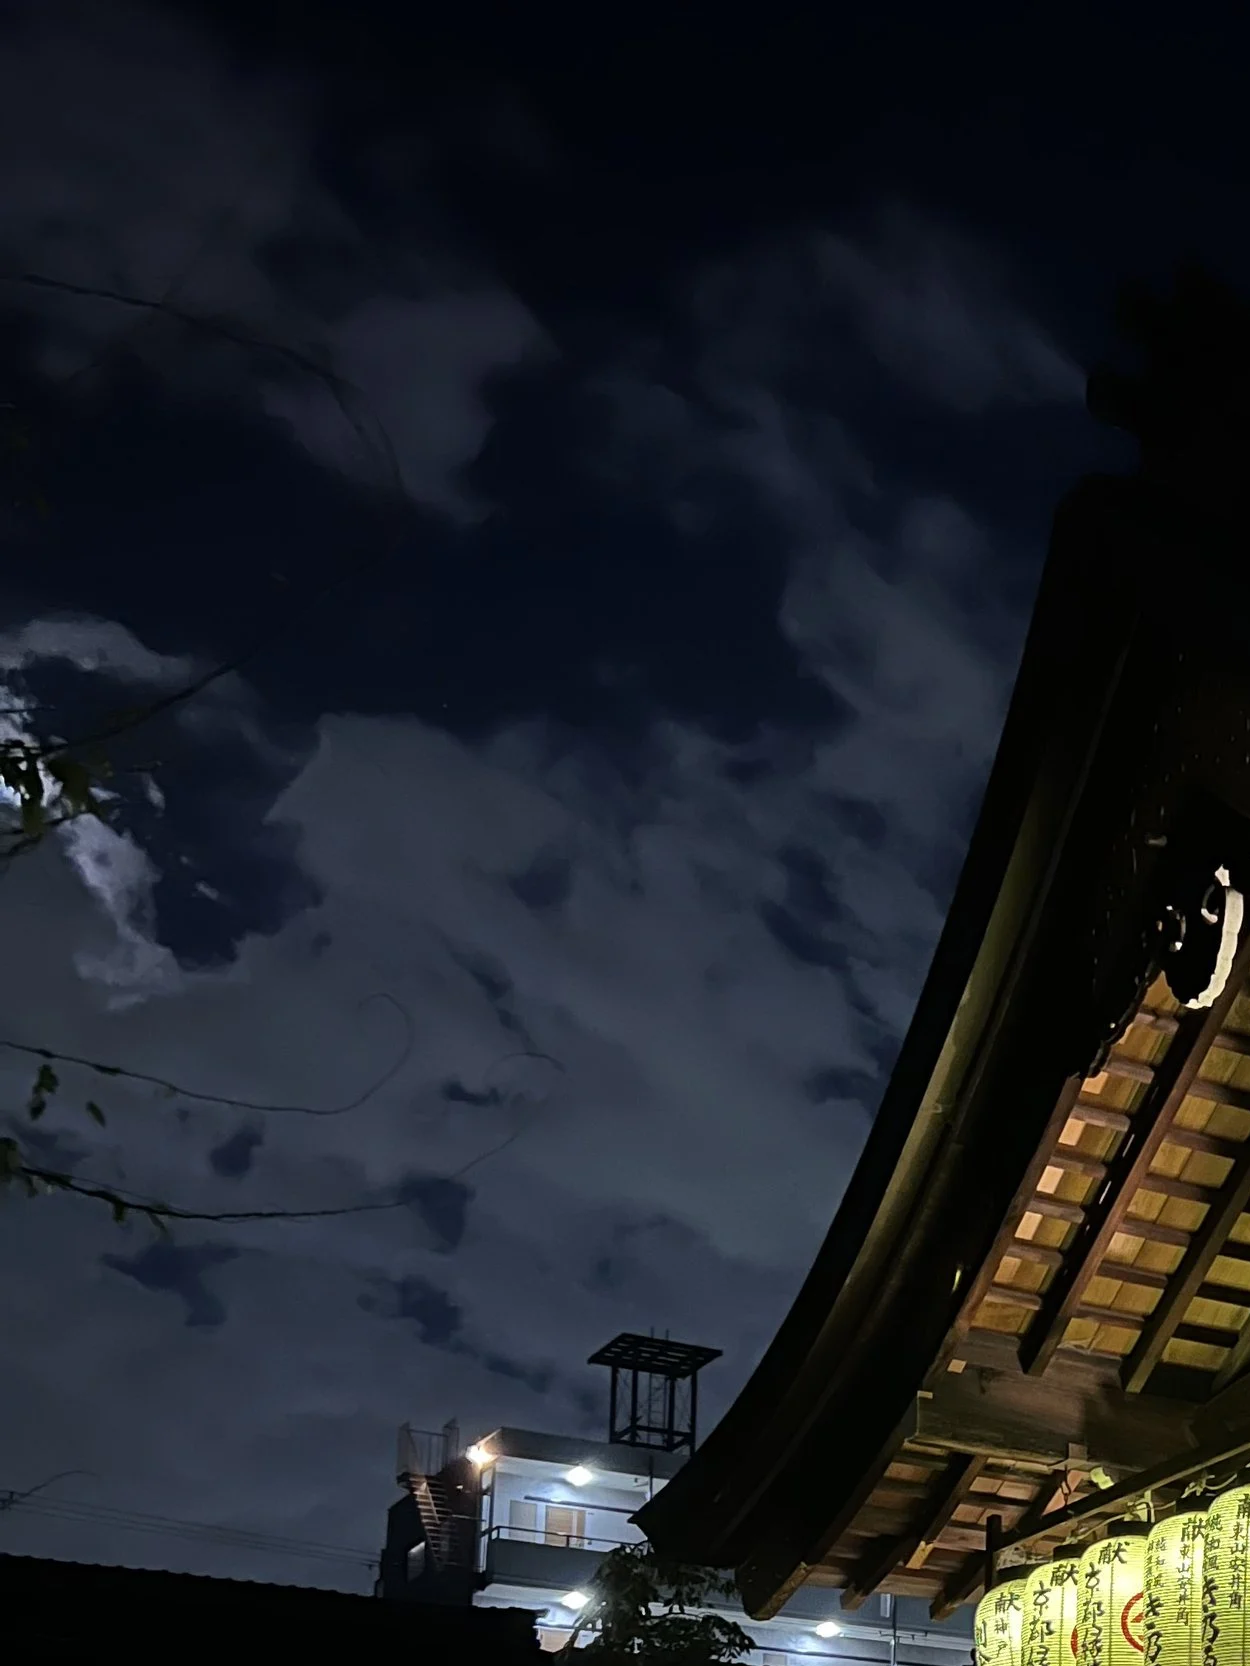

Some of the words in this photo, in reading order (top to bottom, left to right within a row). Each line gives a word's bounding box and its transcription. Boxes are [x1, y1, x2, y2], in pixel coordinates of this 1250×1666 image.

[1098, 1541, 1130, 1564] 献
[1050, 1562, 1079, 1587] 献
[994, 1592, 1021, 1614] 献
